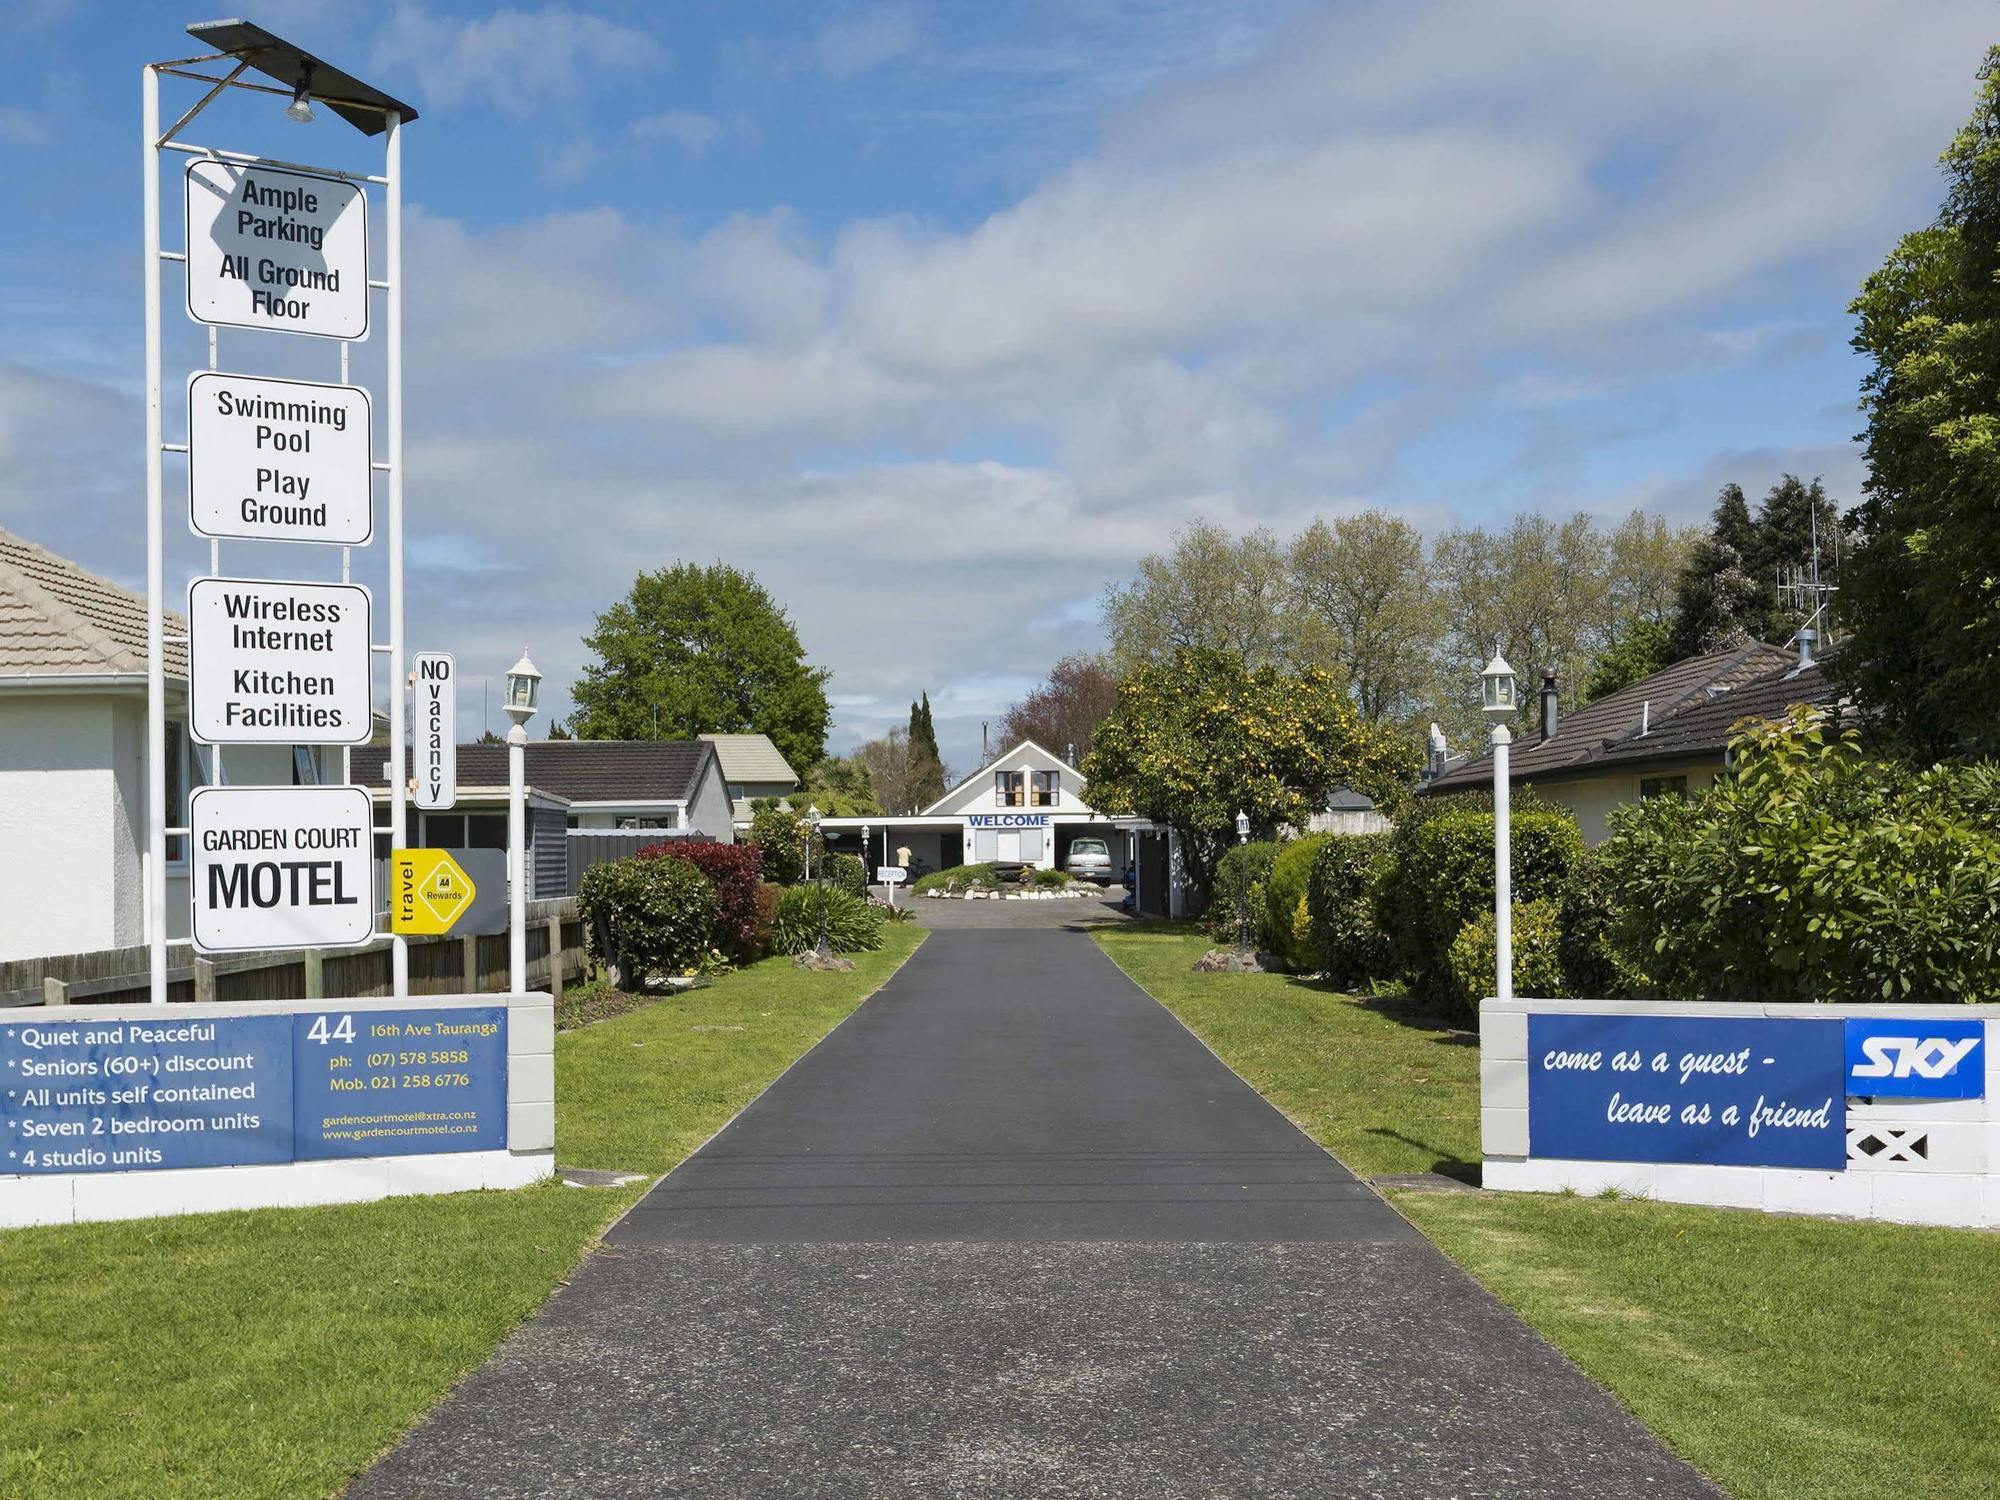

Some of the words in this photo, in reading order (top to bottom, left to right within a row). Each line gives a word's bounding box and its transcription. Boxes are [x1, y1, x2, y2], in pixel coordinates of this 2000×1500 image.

[241, 179, 318, 214] Ample
[237, 210, 324, 251] Parking
[219, 254, 249, 281] All
[257, 258, 340, 293] Ground
[251, 290, 311, 320] Floor
[217, 390, 347, 431] Swimming
[255, 425, 311, 454] Pool
[255, 468, 311, 500] Play
[240, 498, 327, 528] Ground
[223, 593, 341, 623] Wireless
[232, 625, 334, 652] Internet
[233, 669, 335, 696] Kitchen
[420, 660, 450, 681] NO
[225, 702, 343, 727] Facilities
[428, 684, 442, 803] vacancy
[968, 815, 1050, 827] WELCOME
[203, 829, 287, 852] GARDEN
[294, 827, 361, 850] COURT
[208, 861, 358, 910] MOTEL
[400, 861, 414, 923] travel
[439, 878, 450, 887] AA
[21, 1028, 79, 1049] Quiet
[84, 1027, 123, 1045] and
[130, 1024, 215, 1043] Peaceful
[307, 1014, 357, 1045] 44
[370, 1023, 400, 1037] 16th
[404, 1023, 431, 1036] Ave
[436, 1022, 498, 1037] Tauranga
[21, 1059, 98, 1077] Seniors
[104, 1056, 160, 1078] (60+)
[165, 1053, 254, 1072] discount
[329, 1055, 352, 1071] ph:
[367, 1053, 395, 1069] (07)
[400, 1052, 426, 1065] 578
[431, 1051, 469, 1064] 5858
[1543, 1050, 1602, 1071] come
[1612, 1052, 1641, 1072] as
[1652, 1054, 1669, 1073] a
[1679, 1049, 1751, 1085] guest
[1851, 1036, 1980, 1079] SKY
[22, 1089, 50, 1107] All
[56, 1087, 106, 1105] units
[112, 1085, 149, 1104] self
[153, 1082, 256, 1103] contained
[329, 1078, 367, 1091] Mob.
[371, 1076, 397, 1089] 021
[403, 1075, 430, 1088] 258
[434, 1073, 470, 1087] 6776
[22, 1119, 85, 1137] Seven
[92, 1117, 105, 1135] 2
[111, 1113, 205, 1135] bedroom
[211, 1112, 261, 1130] units
[322, 1111, 476, 1128] gardencourtmotel@xtra.co.nz
[1607, 1092, 1671, 1125] leave
[1681, 1105, 1711, 1126] as
[1722, 1107, 1741, 1127] a
[1749, 1096, 1833, 1138] friend
[322, 1124, 478, 1141] www.gardencourtmotel.co.nz
[23, 1150, 36, 1167] 4
[42, 1149, 107, 1167] studio
[112, 1147, 163, 1164] units
